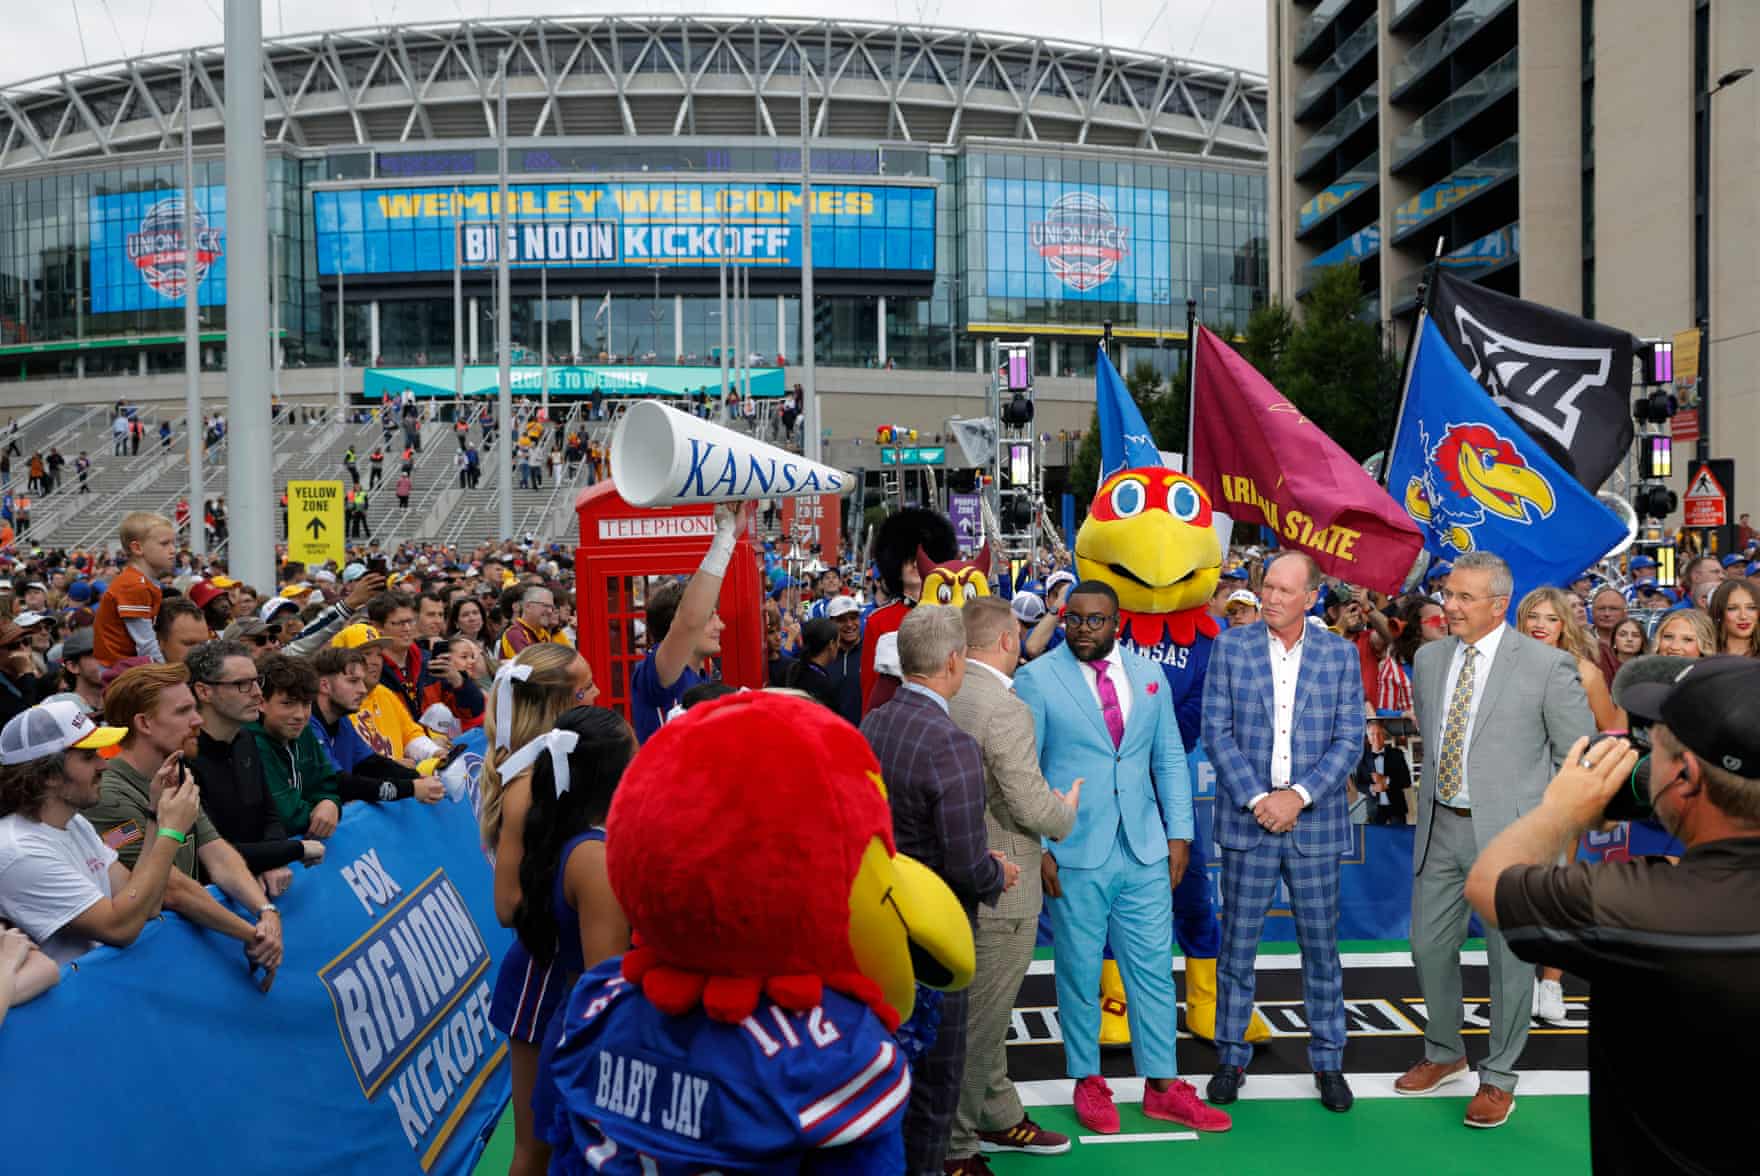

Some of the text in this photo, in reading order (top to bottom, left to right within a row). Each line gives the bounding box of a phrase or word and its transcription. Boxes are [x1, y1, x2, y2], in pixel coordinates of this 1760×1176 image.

[378, 188, 874, 218] WEMBLEY WELCOMES
[524, 224, 614, 260] NOON
[624, 226, 790, 256] KICKOFF
[1032, 225, 1128, 251] UNION JACK
[496, 371, 649, 391] ELCOE TO WEMBLEY
[672, 437, 842, 497] KANSAS
[295, 487, 337, 498] YELLOW
[303, 500, 329, 512] ZONE
[1283, 510, 1362, 561] STATE
[1125, 638, 1190, 669] ANSAS
[338, 847, 402, 918] FOX
[333, 879, 483, 1078] BIG NOON
[388, 979, 497, 1149] KICKOFF
[595, 1050, 710, 1140] BABY JAY
